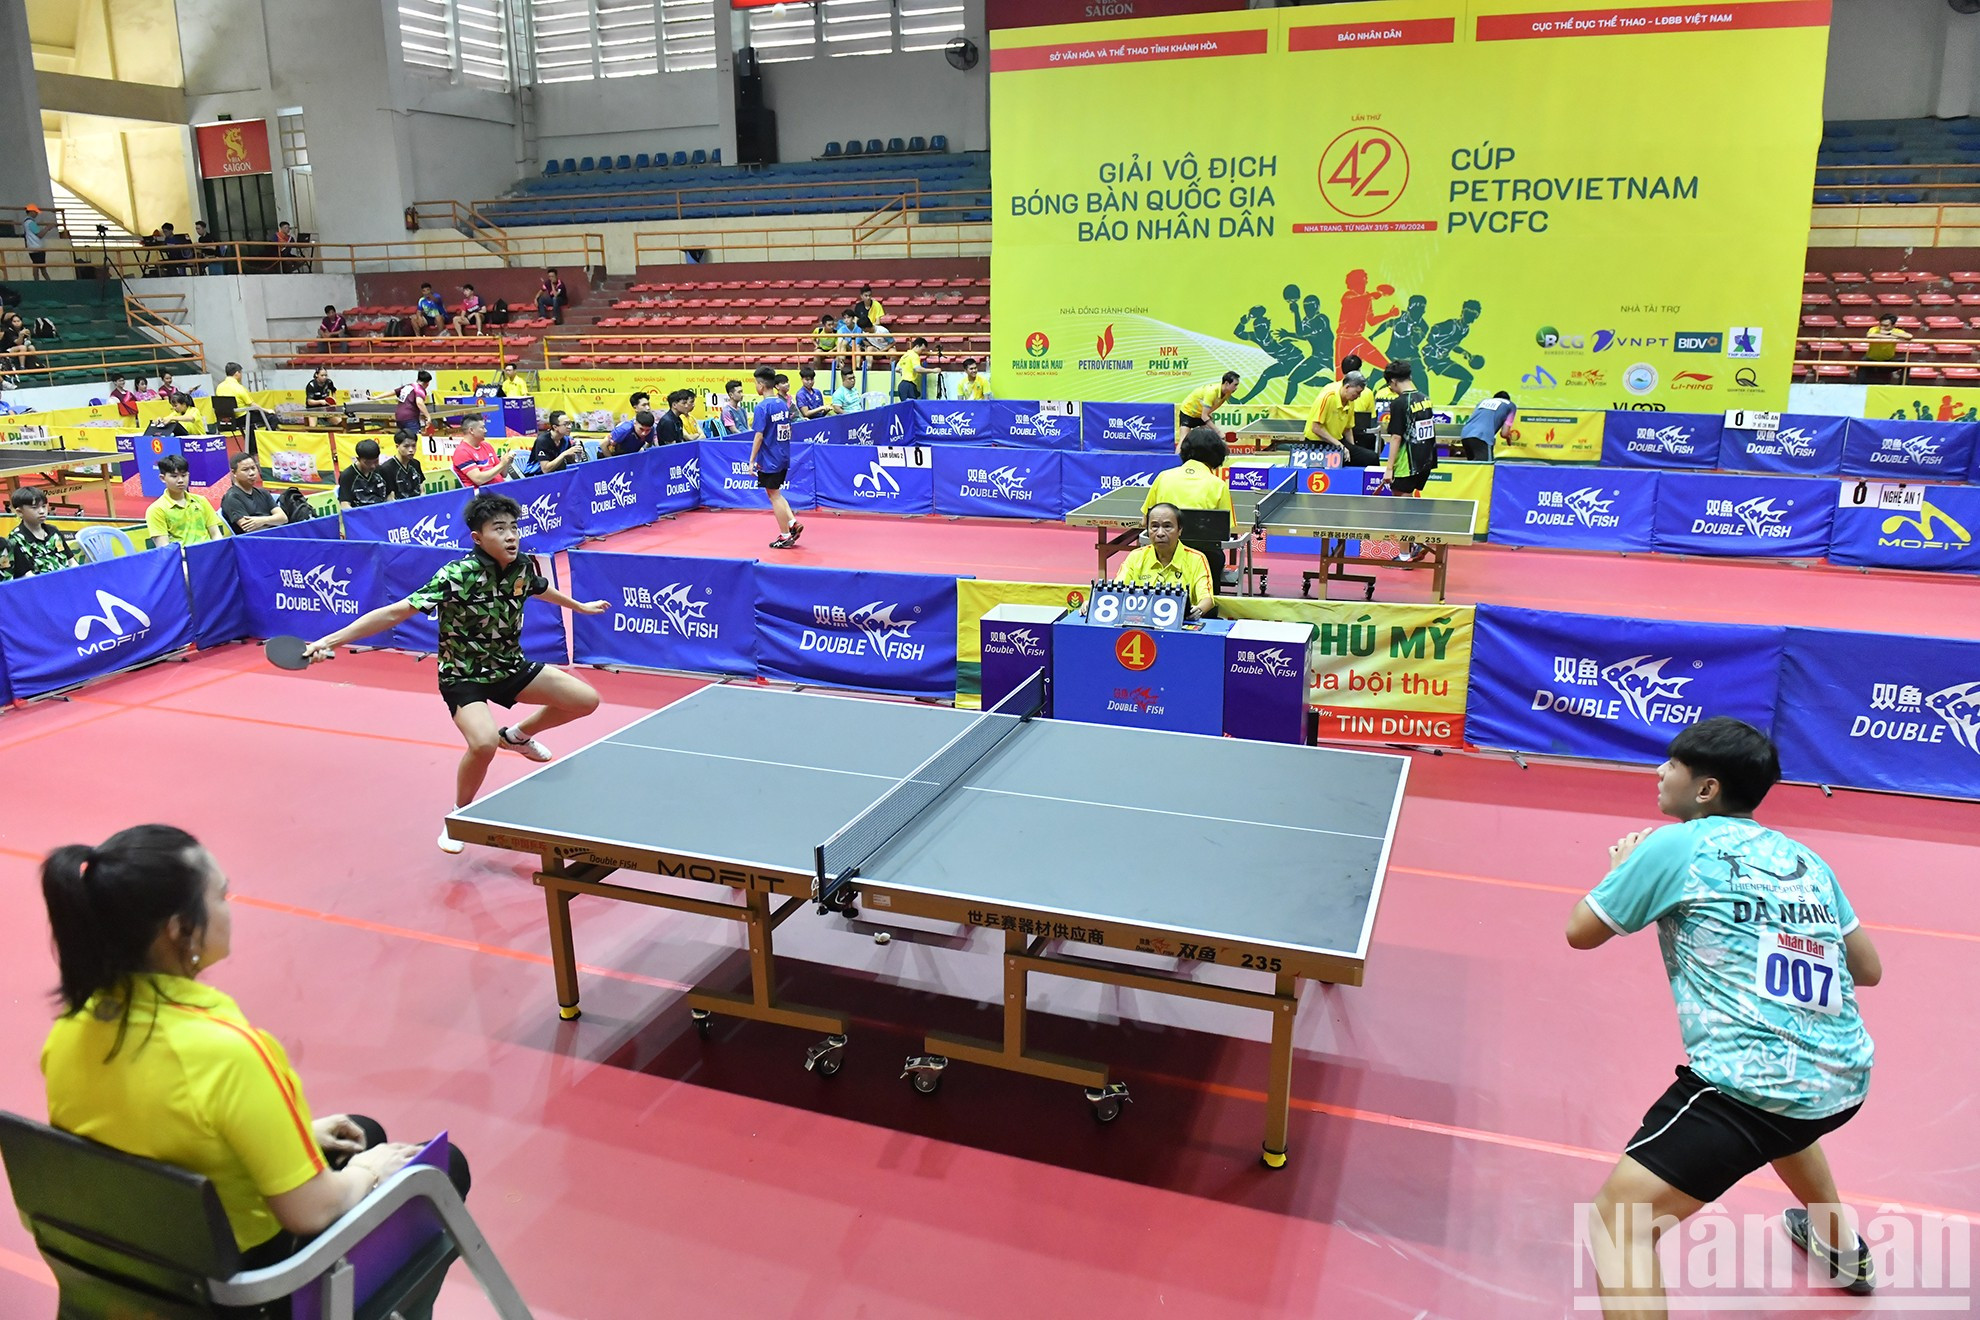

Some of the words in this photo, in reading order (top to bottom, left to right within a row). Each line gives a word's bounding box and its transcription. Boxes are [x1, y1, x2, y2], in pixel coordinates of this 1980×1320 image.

[1085, 4, 1134, 17] SAIGON
[1532, 21, 1552, 32] CỤC
[1554, 17, 1574, 30] THỂ
[1575, 20, 1596, 30] DỤC
[1598, 15, 1618, 28] THỂ
[1619, 17, 1646, 27] THAO
[1654, 15, 1682, 26] LĐBB
[1684, 12, 1708, 25] VIỆT
[1710, 13, 1732, 24] NAM
[1338, 31, 1356, 42] BÁO
[1357, 29, 1382, 40] NHÂN
[1383, 28, 1402, 40] DÂN
[1050, 51, 1061, 61] SỞ
[1062, 50, 1078, 60] VĂN
[1079, 49, 1096, 60] HÓA
[1097, 47, 1108, 58] VÀ
[1109, 45, 1125, 56] THỂ
[1127, 46, 1149, 55] THAO
[1150, 43, 1170, 54] TỈNH
[1170, 42, 1199, 53] KHÁNH
[1200, 41, 1218, 50] HÒA
[1451, 140, 1516, 170] CÚP
[224, 162, 252, 172] SAIGON
[1100, 153, 1152, 183] GIẢI
[1163, 151, 1198, 181] VÔ
[1208, 155, 1277, 184] ĐỊCH
[1327, 138, 1392, 196] 42
[1011, 189, 1078, 216] BÓNG
[1086, 186, 1138, 214] BÀN
[1146, 177, 1222, 212] QUỐC
[1230, 186, 1275, 208] GIA
[1449, 176, 1698, 202] PETROVIETNAM
[1078, 215, 1128, 242] BÁO
[1136, 210, 1210, 240] NHÂN
[1218, 209, 1274, 238] DÂN
[1355, 224, 1374, 232] NGÀY
[1394, 222, 1425, 231] 7/6/2024
[1448, 210, 1549, 234] PVCFC
[1060, 306, 1076, 314] NHÀ
[1078, 306, 1100, 314] ĐỒNG
[1100, 305, 1123, 314] HÀNH
[1124, 304, 1148, 314] CHÍNH
[1620, 304, 1641, 313] NHÀ
[1644, 304, 1659, 313] TÀI
[1661, 305, 1681, 315] TRỢ
[1616, 337, 1669, 347] VNPT
[1678, 336, 1708, 349] BIDV
[1160, 346, 1178, 356] NPK
[1012, 359, 1027, 370] PHÂN
[1050, 360, 1063, 370] MAU
[1078, 360, 1133, 370] PETROVIETNAM
[1149, 358, 1170, 370] PHÚ
[1173, 358, 1189, 369] MỸ
[1212, 410, 1242, 426] PHÚ
[1735, 412, 1744, 426] 0
[926, 426, 951, 435] DOUBLE
[960, 426, 976, 435] FISH
[1010, 426, 1036, 436] DOUBLE
[1045, 426, 1061, 436] FISH
[1103, 430, 1131, 440] DOUBLE
[1140, 430, 1156, 440] FISH
[1418, 426, 1433, 438] 077
[429, 437, 436, 454] 0
[1627, 442, 1663, 453] DOUBLE
[1674, 445, 1694, 454] FISH
[1746, 443, 1782, 455] DOUBLE
[1794, 448, 1816, 457] FISH
[914, 448, 923, 466] 0
[1292, 451, 1308, 467] 12
[1325, 452, 1340, 467] 10
[1870, 452, 1910, 464] DOUBLE
[1920, 455, 1943, 465] FISH
[666, 482, 690, 496] DOUBLE
[724, 477, 759, 490] DOUBLE
[1311, 473, 1326, 491] 5
[960, 485, 998, 498] DOUBLE
[1010, 490, 1032, 500] FISH
[1538, 491, 1564, 508] 双魚
[1853, 482, 1867, 505] 0
[1904, 492, 1914, 504] AN
[591, 497, 616, 514] DOUBLE
[623, 494, 637, 506] FISH
[1706, 500, 1733, 516] 双魚
[548, 516, 562, 530] FISH
[1525, 510, 1576, 526] DOUBLE
[1591, 515, 1620, 527] FISH
[1691, 519, 1745, 536] DOUBLE
[1760, 524, 1792, 538] FISH
[1878, 538, 1970, 550] MOFIT
[280, 569, 305, 589] 双魚
[276, 592, 320, 612] DOUBLE
[335, 599, 358, 614] FISH
[622, 586, 651, 609] 双魚
[813, 605, 848, 628] 双魚
[1094, 595, 1119, 622] 8
[1152, 598, 1178, 626] 9
[614, 612, 669, 636] DOUBLE
[687, 621, 718, 638] FISH
[77, 626, 150, 657] MOFIT
[799, 629, 868, 656] DOUBLE
[887, 641, 925, 661] FISH
[1313, 614, 1376, 658] PHÚ
[1390, 617, 1454, 660] MỸ
[984, 644, 1014, 655] Double
[1027, 648, 1045, 656] FISH
[1122, 635, 1144, 665] 4
[1230, 664, 1264, 675] Double
[1277, 669, 1297, 678] FISH
[1553, 656, 1598, 686] 双魚
[1348, 670, 1391, 696] bội
[1402, 672, 1448, 696] thu
[1870, 682, 1922, 714] 双魚
[1107, 700, 1138, 712] DOUBLE
[1146, 705, 1164, 715] FISH
[1531, 690, 1622, 720] DOUBLE
[1650, 702, 1702, 724] FISH
[1336, 715, 1374, 734] TIN
[1382, 715, 1450, 738] DÙNG
[1850, 715, 1946, 744] DOUBLE
[590, 854, 617, 867] Double
[619, 859, 637, 869] FISH
[657, 859, 784, 894] MOFIT
[1733, 896, 1772, 923] ĐÀ
[967, 909, 1105, 945] 世乒赛器材供应商
[1241, 954, 1282, 972] 235
[1765, 953, 1833, 1007] 007
